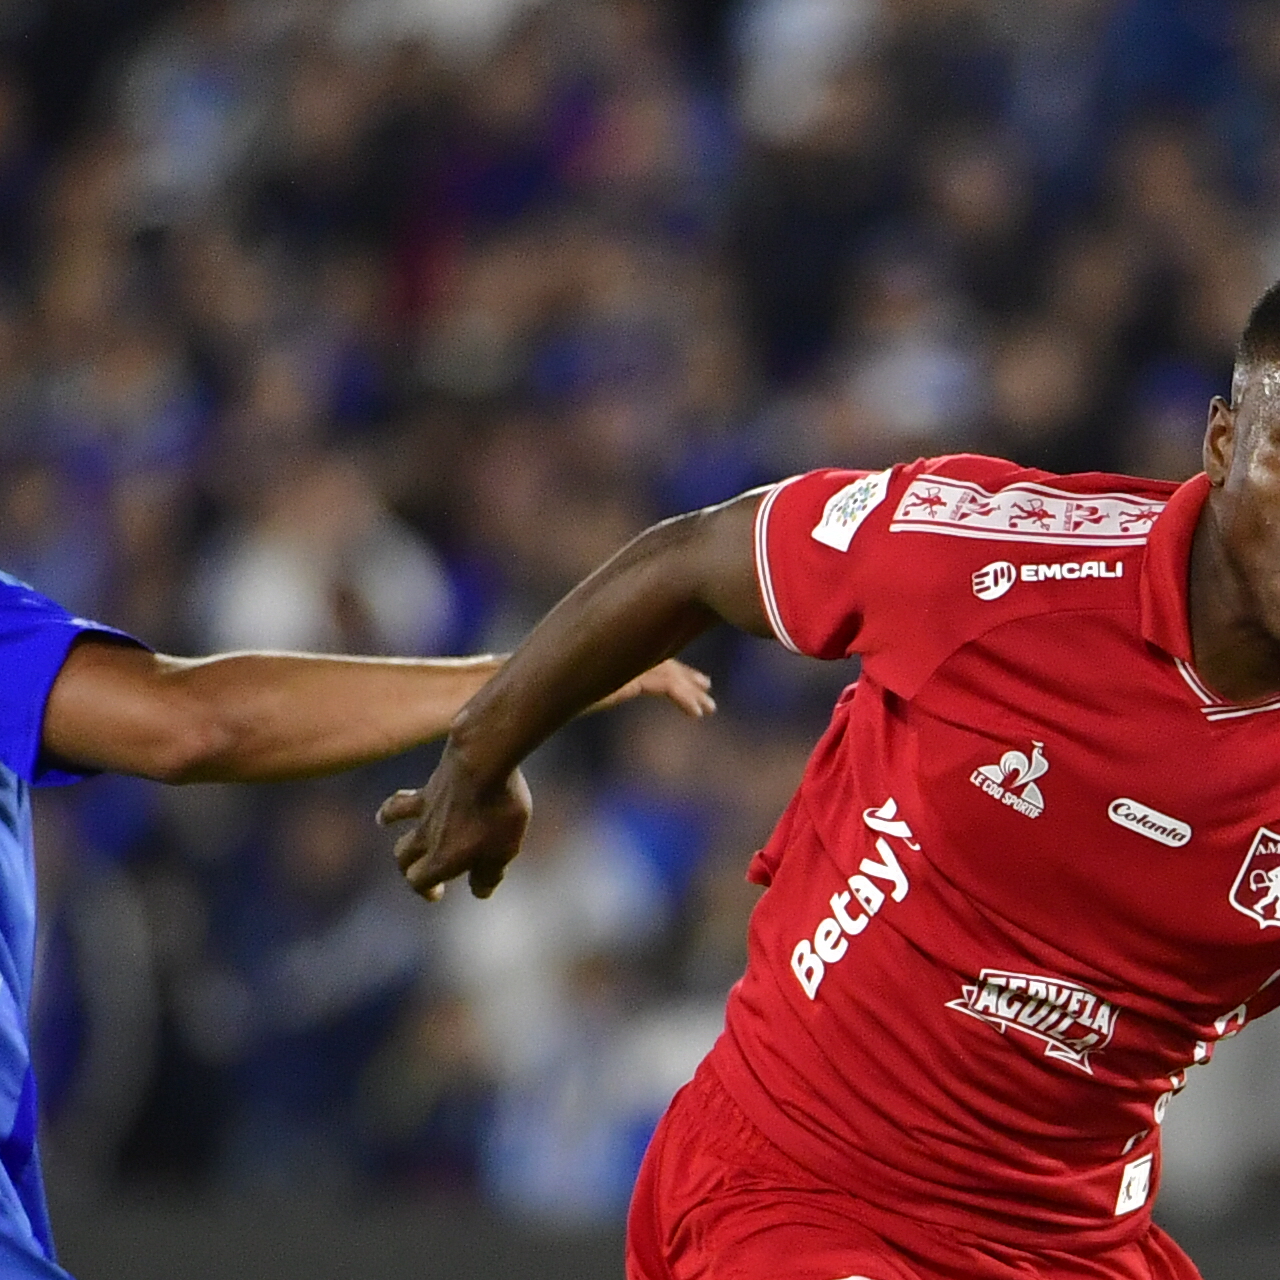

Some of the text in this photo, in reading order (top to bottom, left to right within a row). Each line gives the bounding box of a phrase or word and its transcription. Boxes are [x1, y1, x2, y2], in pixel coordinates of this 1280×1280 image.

[1021, 561, 1122, 581] EMCALI
[970, 769, 986, 787] LE
[1001, 791, 1043, 819] SPORTIF
[1112, 803, 1187, 842] Colanta
